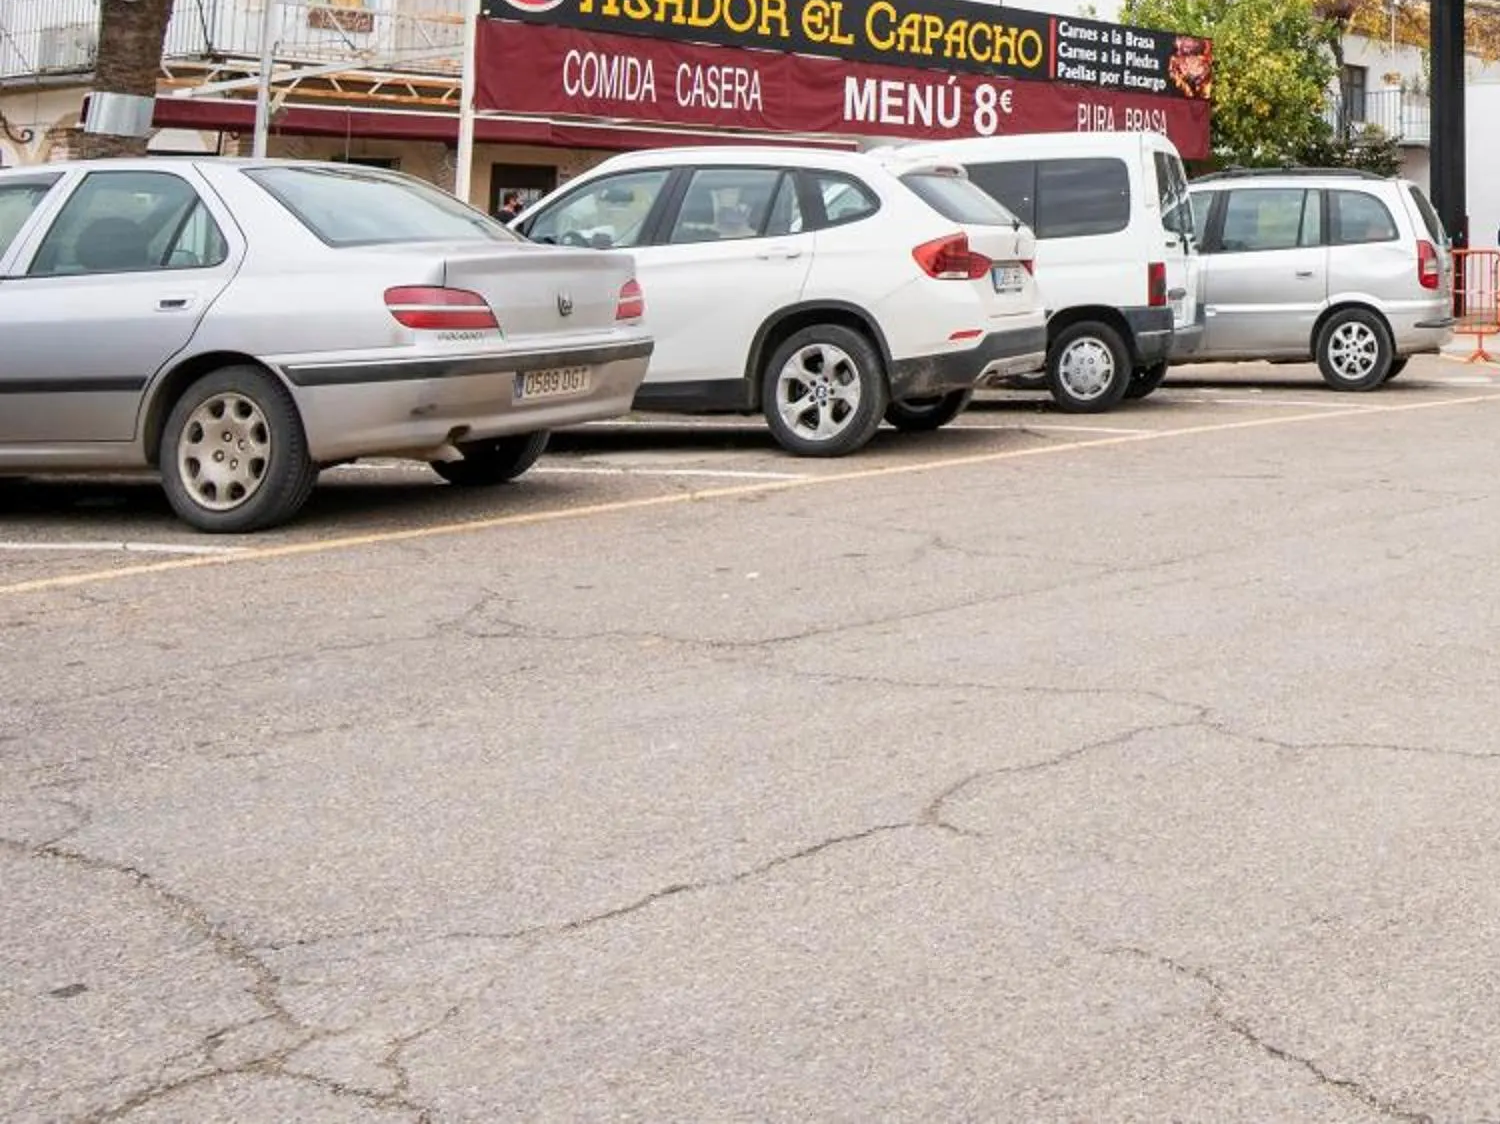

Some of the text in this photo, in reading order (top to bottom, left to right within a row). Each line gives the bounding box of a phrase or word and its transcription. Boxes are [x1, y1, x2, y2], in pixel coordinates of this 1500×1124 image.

[865, 1, 1043, 68] CAPACHO
[1058, 21, 1155, 50] Carnes a la Brasa
[1057, 42, 1159, 70] Carnes a la Piedra
[563, 49, 763, 112] COMIDA CASERA
[1057, 62, 1167, 92] Paellas por Encargo
[843, 75, 1013, 136] MENÚ 8€
[1077, 103, 1168, 137] PURA BRASA
